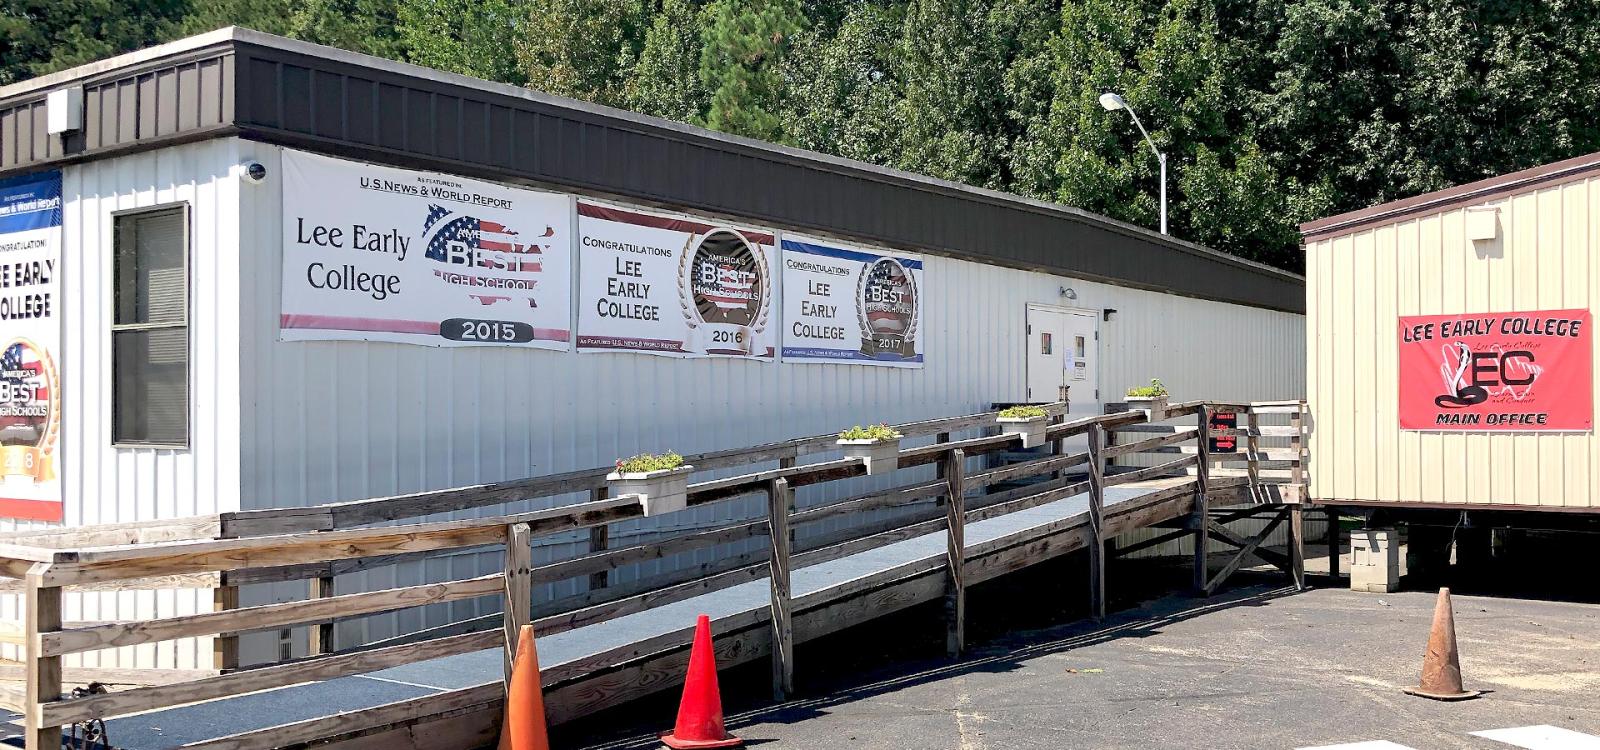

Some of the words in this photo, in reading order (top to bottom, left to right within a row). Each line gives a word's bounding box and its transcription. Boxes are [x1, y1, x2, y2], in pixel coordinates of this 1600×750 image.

[420, 186, 429, 196] &
[431, 187, 471, 202] WORLD
[473, 194, 513, 209] REPORT
[297, 217, 343, 248] Lee
[353, 224, 410, 261] Early
[583, 236, 672, 258] CONGRATULATIONS
[616, 256, 642, 278] LEE
[708, 254, 746, 266] AMERICA'S
[786, 259, 850, 276] CONGRATULATIONS
[15, 258, 56, 287] EARLY
[307, 262, 401, 301] College
[702, 261, 751, 287] BEST
[477, 276, 538, 291] SCHOOL
[607, 277, 651, 300] EARLY
[693, 284, 718, 297] HIGH
[808, 280, 831, 297] LEE
[870, 285, 904, 304] BEST
[0, 293, 51, 320] OLLEGE
[597, 298, 660, 322] COLLEGE
[801, 300, 837, 319] EARLY
[461, 321, 516, 341] 2015
[712, 330, 743, 343] 2016
[792, 321, 845, 340] COLLEGE
[1403, 323, 1435, 343] LEE
[1440, 318, 1496, 339] EARLY
[1500, 316, 1582, 338] COLLEGE
[879, 338, 901, 349] 2017
[0, 381, 40, 403] BEST
[12, 406, 47, 417] SCHOOLS
[1436, 413, 1481, 425] MAIN
[1486, 413, 1548, 425] OFFICE
